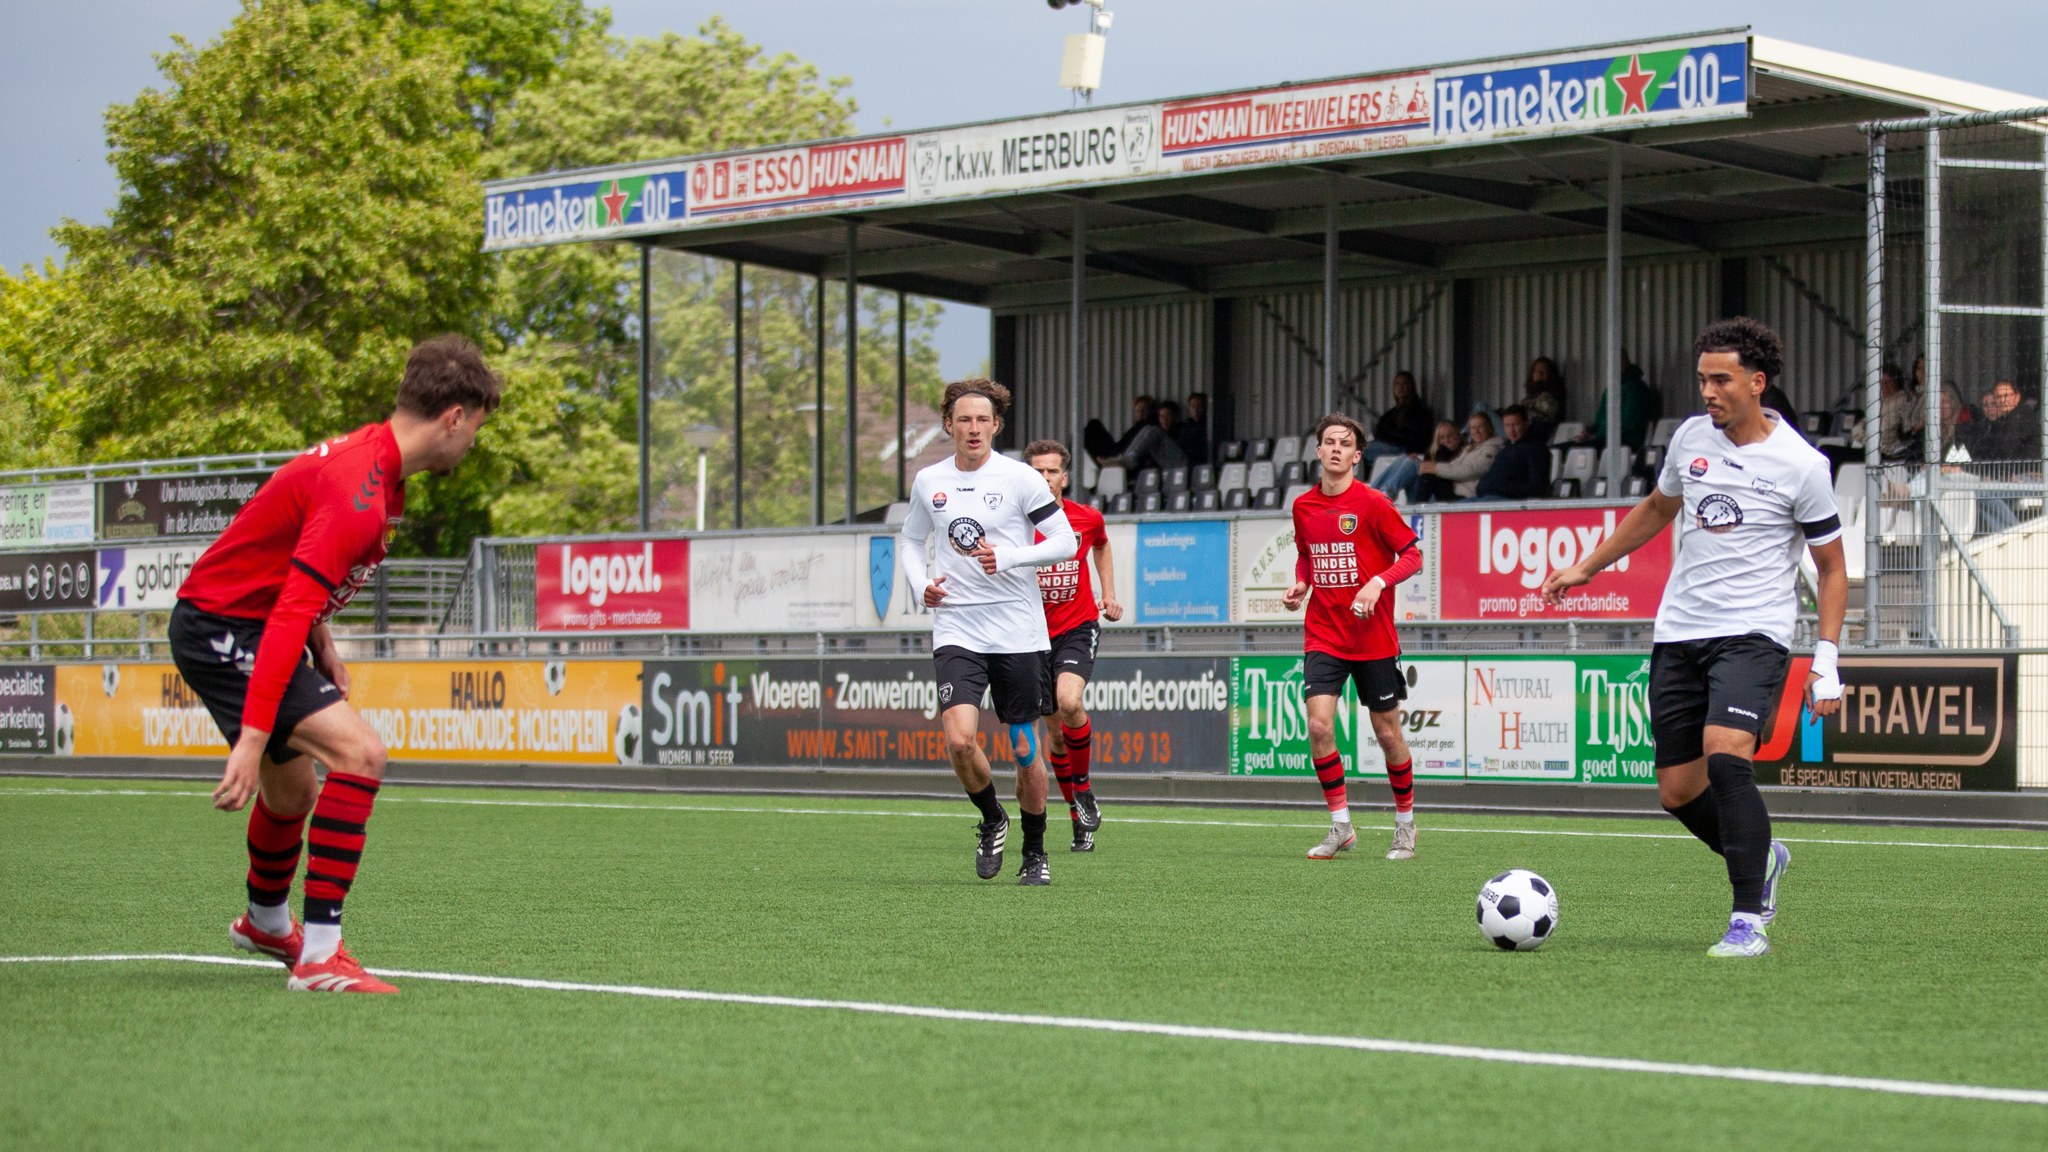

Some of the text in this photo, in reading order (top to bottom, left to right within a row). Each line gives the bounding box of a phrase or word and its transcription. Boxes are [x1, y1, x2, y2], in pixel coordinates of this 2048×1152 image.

[1435, 69, 1608, 136] Heineken
[1165, 91, 1382, 146] HUISMAN TWEEWIELERS
[945, 126, 1116, 182] r.k.v.v. MEERBURG
[1379, 134, 1408, 150] LEIDEN
[754, 144, 905, 194] ESSO HUISMAN
[486, 188, 598, 239] Heineken
[34, 493, 46, 509] en
[162, 482, 176, 502] Uw
[177, 479, 226, 506] biologische
[166, 514, 175, 533] in
[176, 512, 187, 533] de
[189, 511, 228, 532] Leidsche
[1310, 542, 1355, 554] VAN DER
[1313, 557, 1357, 569] LINDEN
[561, 542, 662, 606] logoxl.
[1042, 574, 1079, 587] NDEN
[1056, 560, 1080, 572] DER
[1313, 573, 1359, 584] GROEP
[1042, 588, 1077, 600] ROEP
[1480, 597, 1516, 616] promo
[1519, 592, 1545, 617] gifts
[1555, 592, 1630, 613] merchandise
[563, 611, 588, 630] promo
[589, 610, 606, 630] gifts
[612, 609, 662, 625] merchandise
[162, 673, 205, 708] HALL
[451, 671, 505, 710] HALLO
[751, 671, 820, 709] Vloeren
[836, 672, 938, 719] Zonwering
[1083, 670, 1228, 711] aamdecoratie
[1473, 668, 1552, 706] NATURAL
[652, 662, 743, 746] Smit
[1245, 668, 1350, 747] TIJSSN
[1841, 685, 1985, 735] TRAVEL
[143, 707, 229, 747] TOPSPORTE
[361, 708, 608, 752] MBO ZOETERWOUDE MOLENPLEIN
[1499, 711, 1568, 750] HEALTH
[659, 750, 734, 765] WONEN IN SFEER
[1094, 731, 1171, 764] 12 39 13
[1367, 737, 1456, 751] The oolest pet gear.
[1245, 747, 1275, 775] goed
[1278, 753, 1307, 769] voor
[1502, 760, 1519, 770] LARS
[1521, 760, 1542, 770] LINDA
[1582, 753, 1617, 783] goed
[1621, 759, 1655, 778] voor
[1781, 764, 1961, 790] DÉ SPECIALIST IN VOETBALREIZEN
